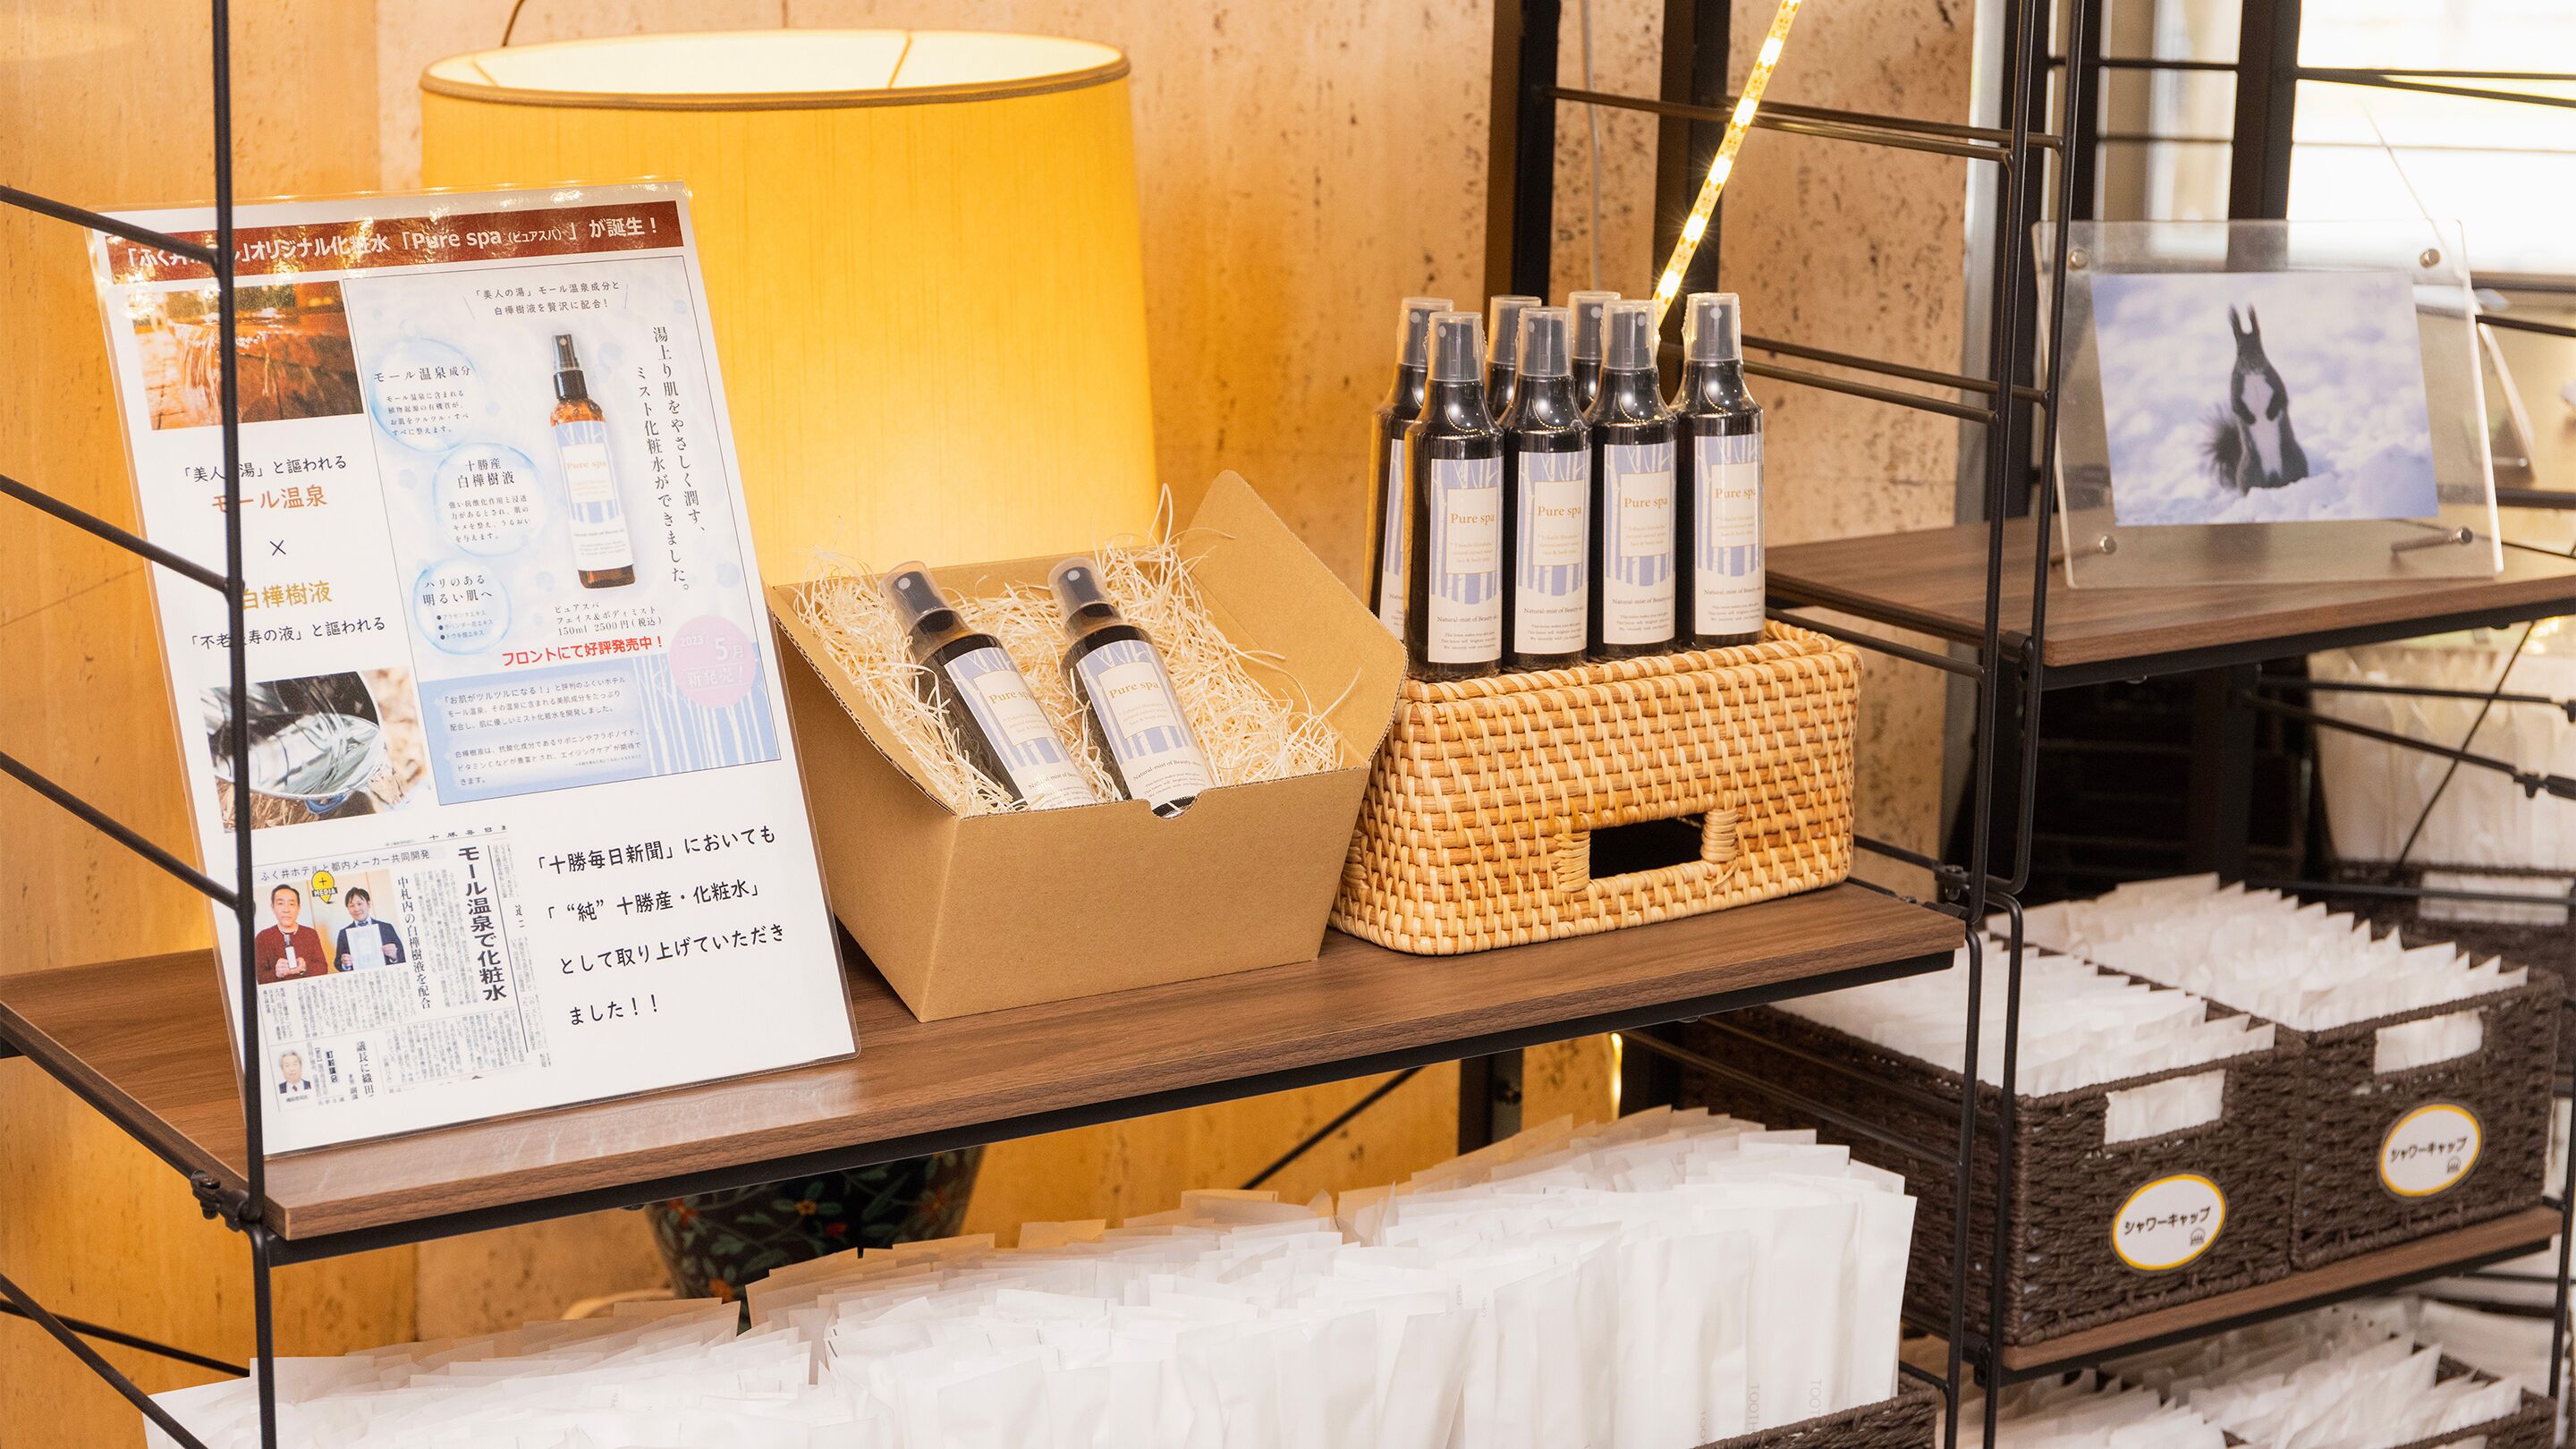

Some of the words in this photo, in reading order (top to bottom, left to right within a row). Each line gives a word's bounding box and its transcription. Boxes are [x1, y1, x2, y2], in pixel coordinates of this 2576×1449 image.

[374, 365, 470, 383] モール温泉成分
[184, 454, 347, 483] 「美人湯」と謳われる
[465, 457, 502, 472] 十勝産
[457, 470, 515, 489] 白樺樹液
[638, 366, 690, 590] ミスト化粧水ができました。
[1538, 504, 1565, 517] Pure
[1566, 505, 1582, 519] spa
[1624, 496, 1651, 509] Pure
[1653, 496, 1669, 510] spa
[1450, 513, 1479, 525] Pure
[1479, 512, 1496, 526] spa
[425, 574, 486, 589] ハリのある
[423, 589, 493, 606] 明るい肌へ
[191, 615, 386, 651] 「不老寿の液」と謳われる
[988, 691, 1017, 706] Pure
[1109, 682, 1139, 699] Pure
[1140, 681, 1160, 691] spa
[538, 825, 775, 875] 「十勝毎日新聞」においても
[458, 846, 507, 1002] モール温泉で化粧水
[397, 877, 431, 1010] 中札内の白樺樹液を配合
[561, 923, 784, 975] として取り上げていただき
[2390, 1135, 2468, 1163] シャワーキャップ
[2124, 1206, 2211, 1235] シャワーキャップ
